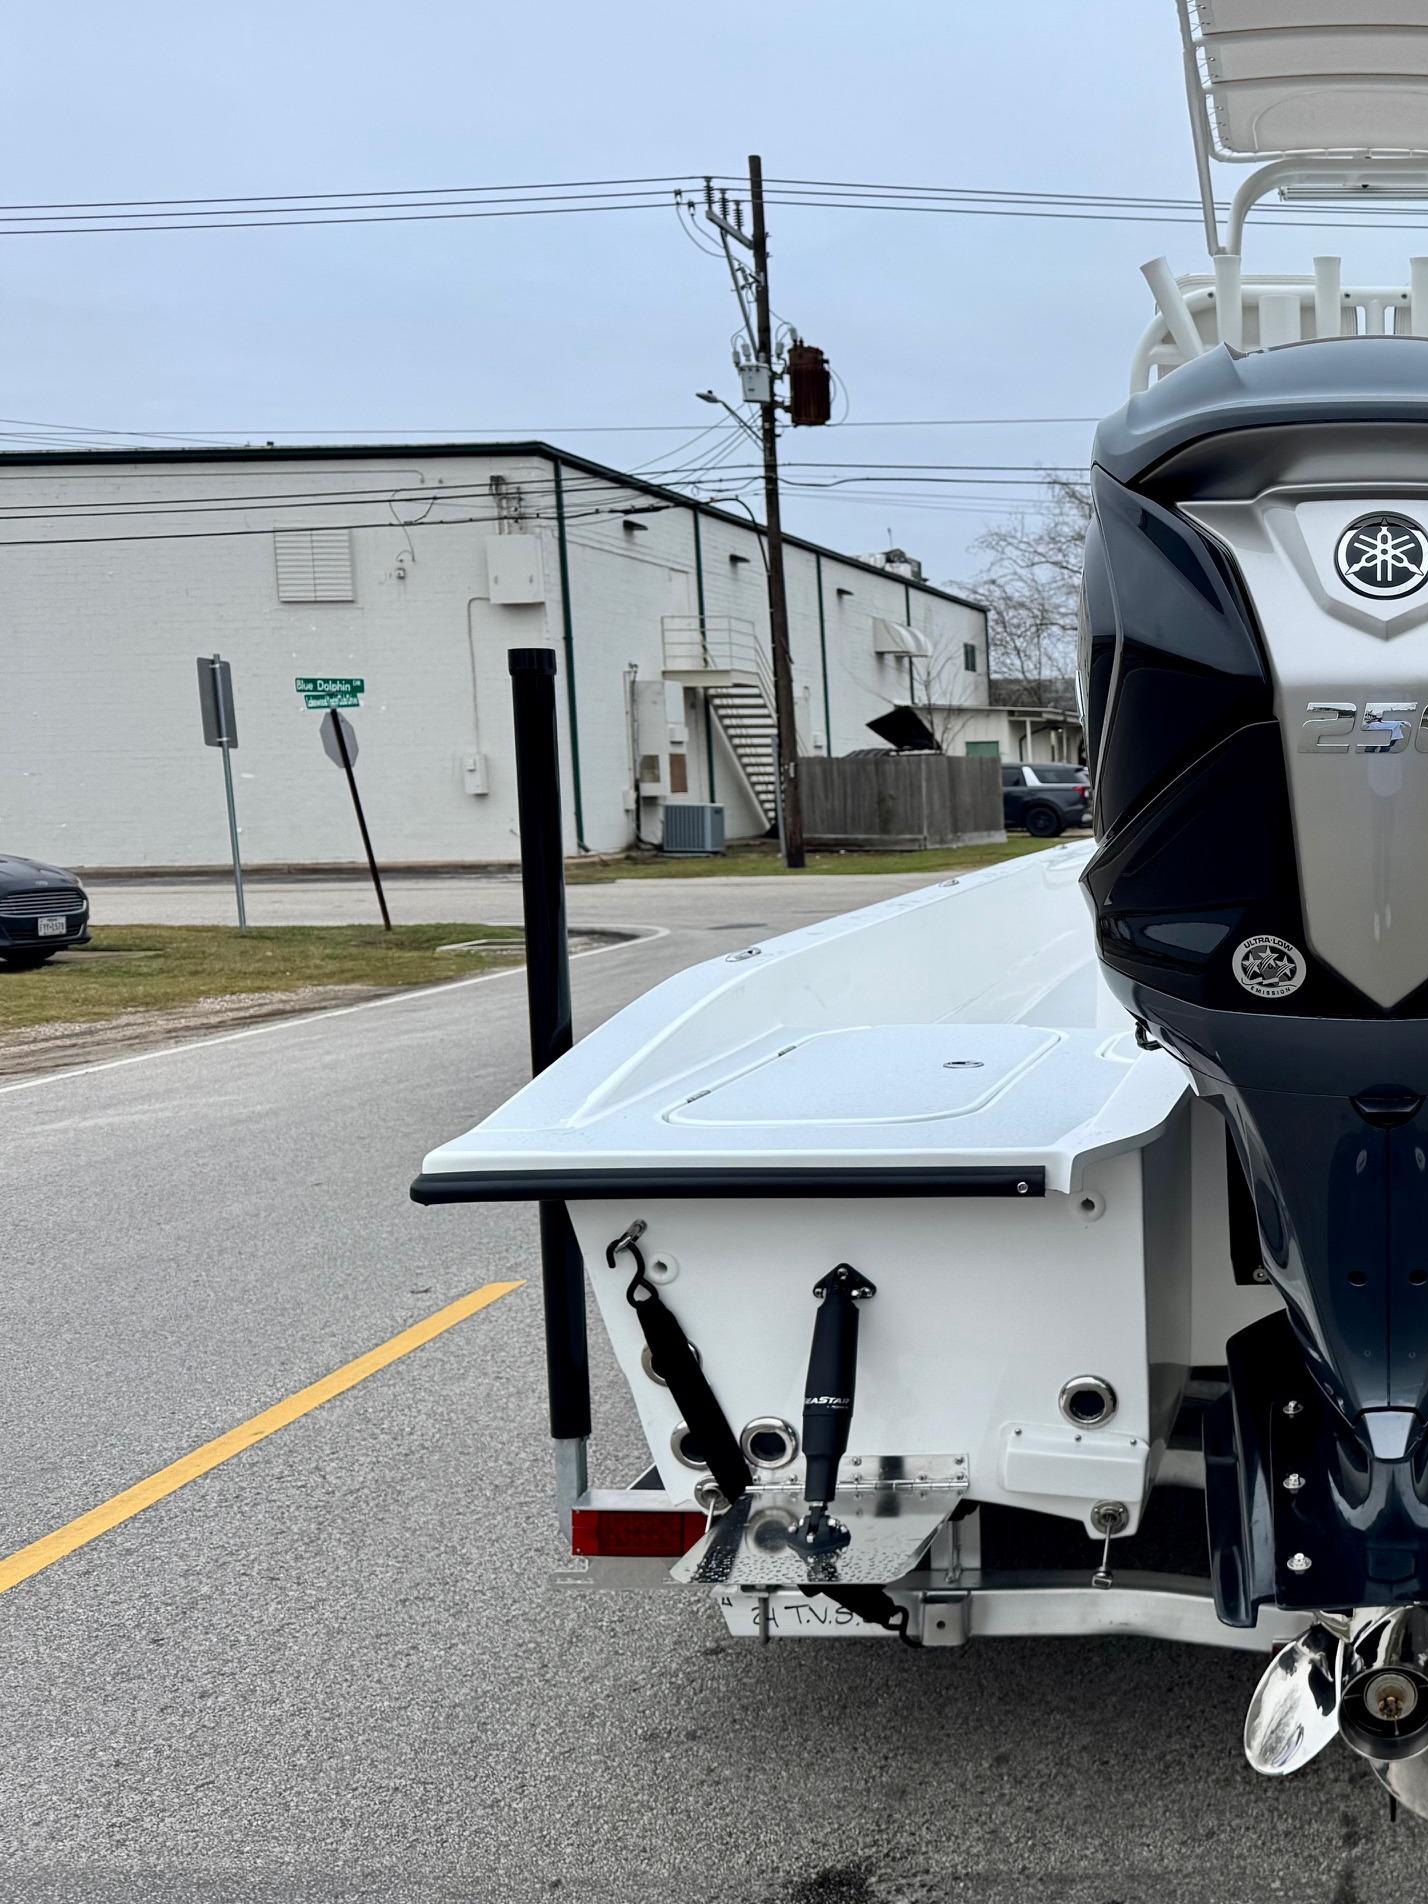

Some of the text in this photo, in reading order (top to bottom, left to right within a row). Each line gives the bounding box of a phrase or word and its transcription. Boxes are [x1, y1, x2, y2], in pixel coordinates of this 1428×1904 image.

[297, 680, 314, 691] Blue
[317, 680, 351, 692] Dolphin
[1250, 985, 1291, 996] EMISSION
[804, 1396, 850, 1405] EASTAR
